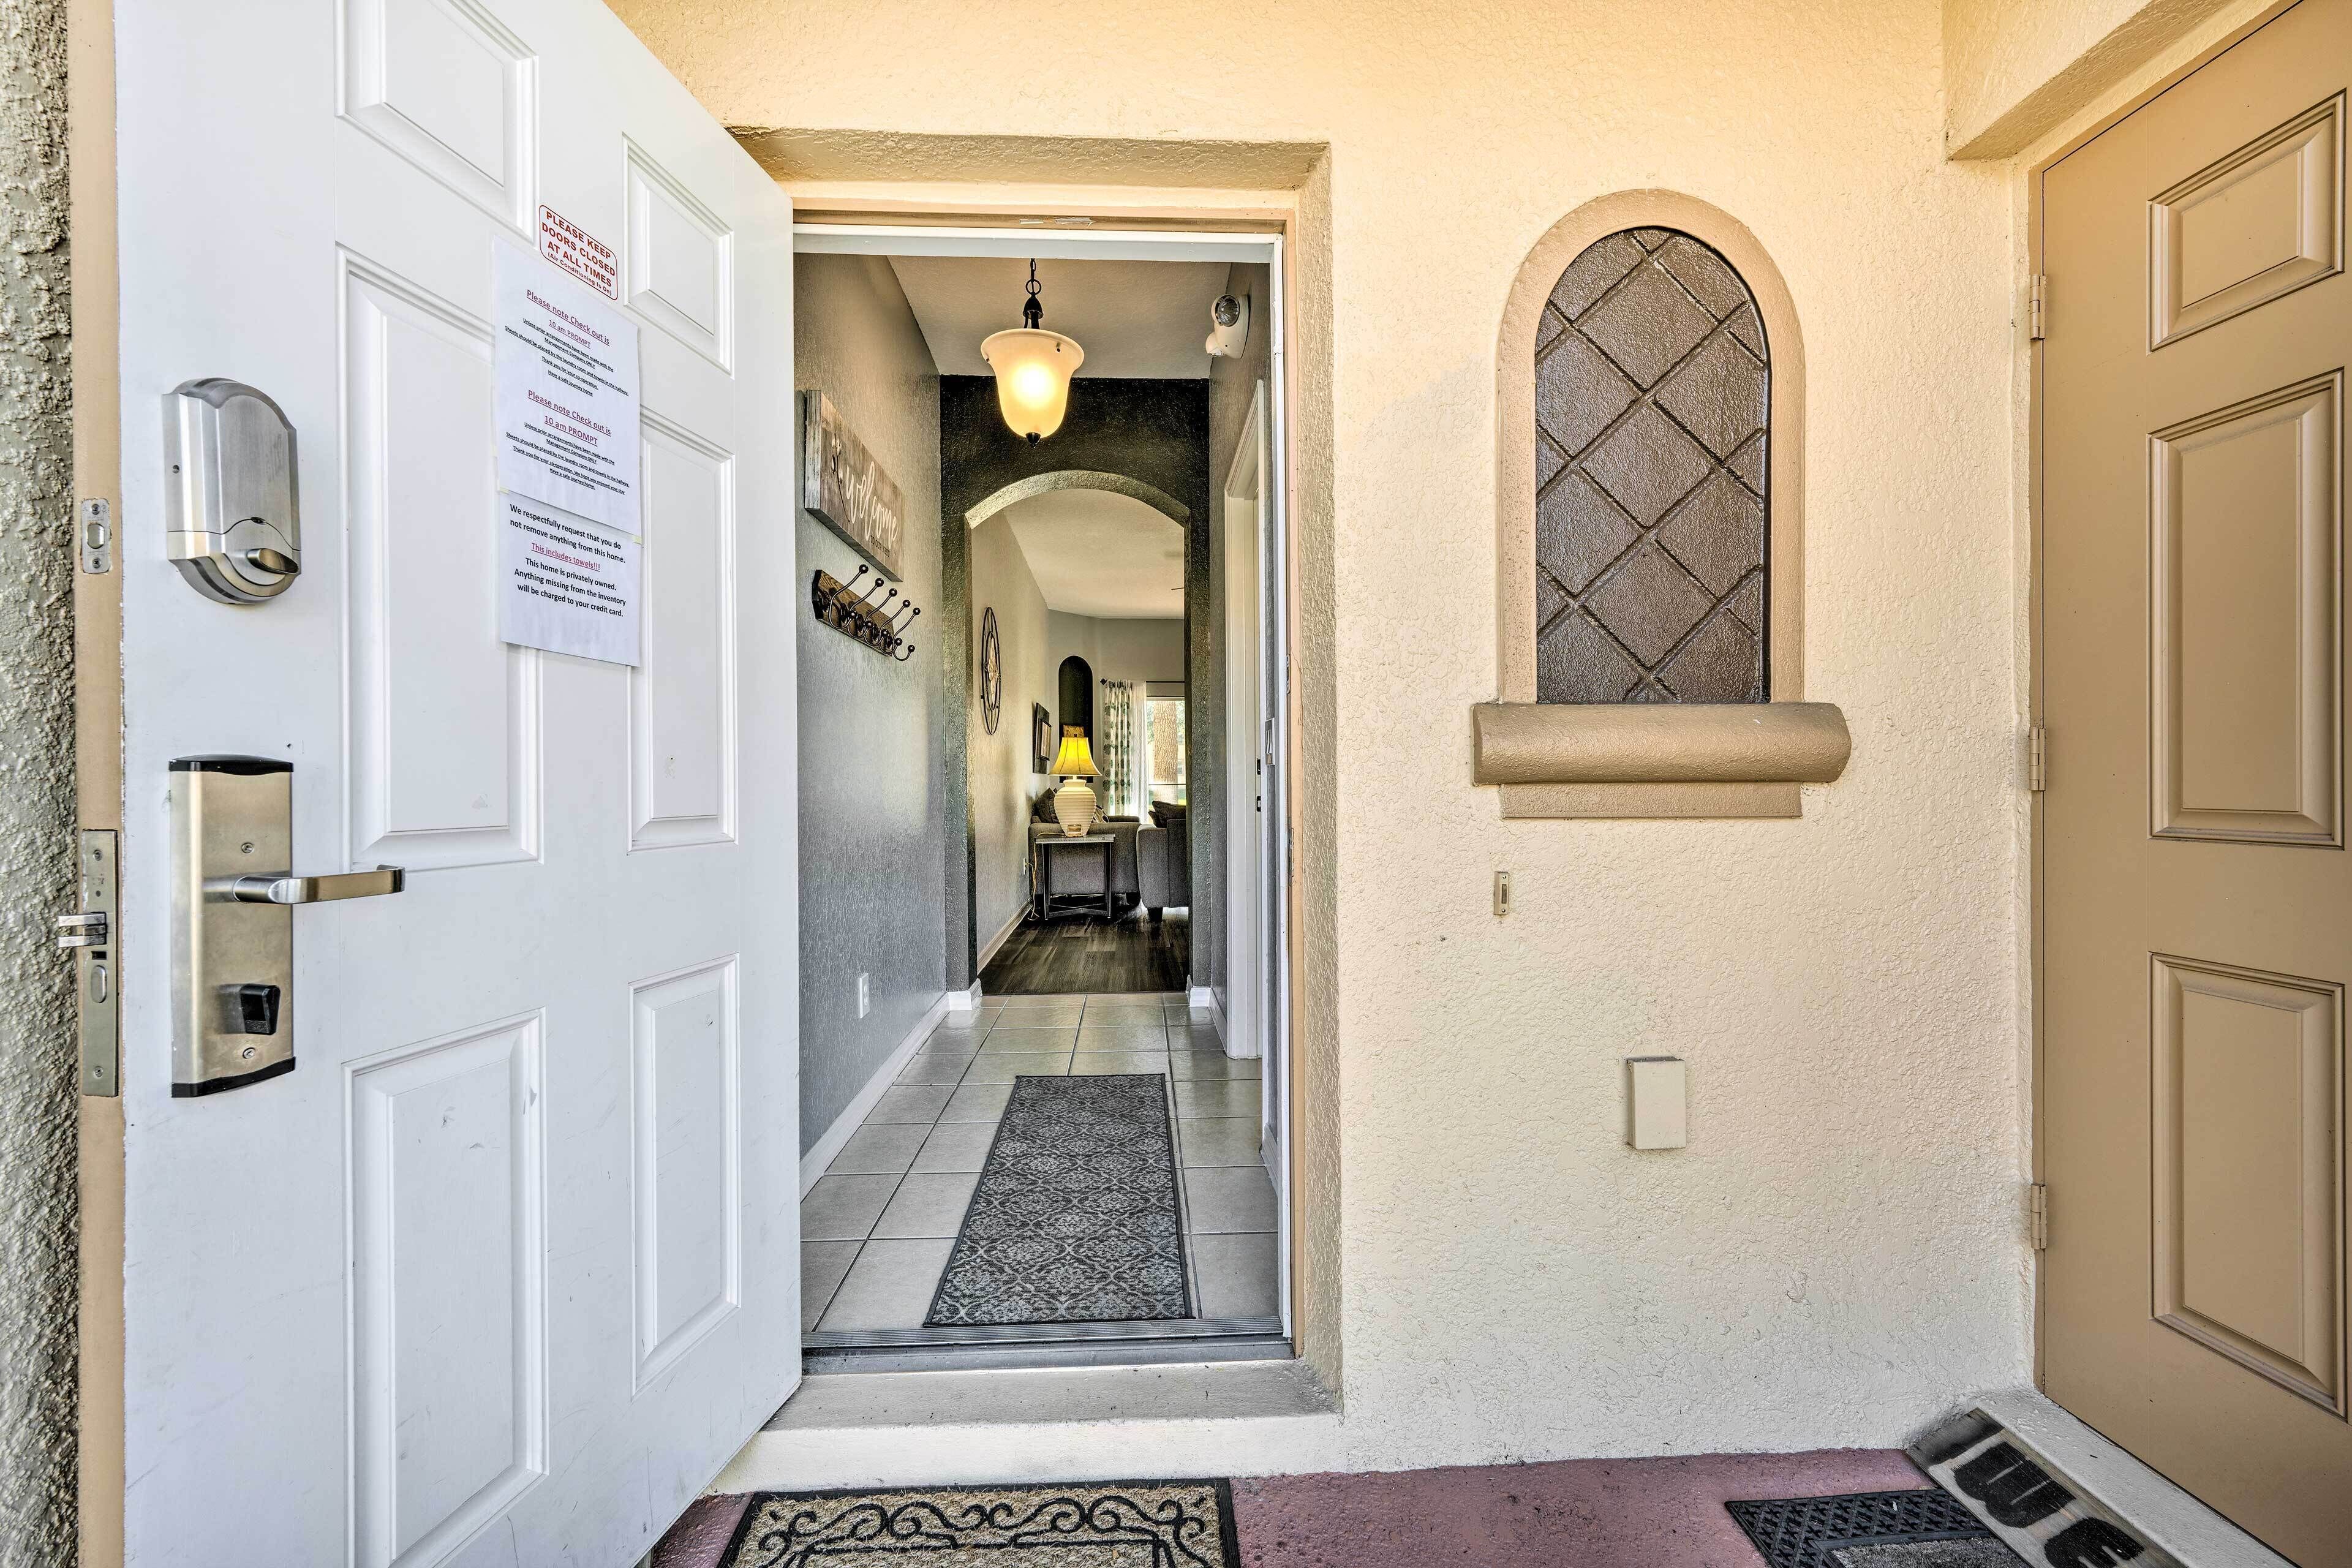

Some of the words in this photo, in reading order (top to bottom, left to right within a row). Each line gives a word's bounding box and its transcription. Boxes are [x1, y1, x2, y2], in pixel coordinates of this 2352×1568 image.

[542, 223, 576, 251] DOORS
[579, 247, 614, 276] CLOSED
[546, 211, 584, 242] PLEASE
[587, 239, 610, 260] KEEP
[548, 241, 560, 255] AT
[563, 251, 581, 267] ALL
[583, 263, 611, 287] TIMES
[548, 252, 558, 262] (Air
[560, 259, 595, 285] Conditioning
[603, 285, 611, 296] On)
[527, 290, 550, 309] Please
[552, 306, 568, 320] note
[570, 315, 590, 333] Check
[592, 330, 603, 340] out
[604, 334, 609, 344] is
[505, 325, 518, 336] Sheets
[519, 334, 531, 343] should
[538, 344, 550, 353] placed
[562, 356, 576, 369] laundry
[594, 373, 605, 382] towels
[523, 318, 535, 328] Unless
[546, 331, 571, 348] arrangements
[580, 350, 589, 358] been
[545, 337, 568, 354] Management
[569, 350, 585, 364] Company
[586, 360, 595, 368] ONLY
[567, 330, 590, 347] PROMPT
[541, 356, 552, 365] Thank
[568, 380, 582, 392] journey
[582, 387, 592, 396] home
[528, 391, 551, 407] Please
[554, 404, 570, 415] note
[571, 411, 591, 426] Check
[593, 422, 604, 431] out
[606, 426, 611, 435] is
[545, 415, 553, 425] 10
[555, 422, 566, 431] am
[568, 426, 597, 445] PROMPT
[513, 445, 524, 454] Thank
[524, 422, 537, 431] Unless
[548, 433, 573, 447] arrangements
[546, 439, 570, 453] Management
[571, 449, 587, 461] Company
[506, 432, 519, 441] Sheets
[565, 456, 578, 467] laundry
[595, 469, 606, 477] towels
[570, 475, 584, 486] journey
[510, 504, 521, 514] We
[523, 510, 560, 530] respectfully
[562, 524, 585, 537] request
[587, 531, 599, 542] that
[613, 540, 620, 549] do
[510, 520, 521, 529] not
[523, 524, 548, 537] remove
[549, 533, 576, 549] anything
[578, 541, 592, 552] from
[594, 546, 605, 556] this
[606, 551, 625, 563] home.
[526, 557, 538, 567] This
[540, 562, 558, 573] home
[566, 571, 593, 586] privately
[594, 579, 616, 590] owned.
[531, 542, 544, 552] This
[546, 547, 571, 561] includes
[573, 555, 600, 570] towels!!!
[514, 568, 543, 584] Anything
[546, 578, 568, 592] missing
[570, 584, 585, 594] from
[587, 589, 597, 597] the
[598, 592, 625, 608] inventory
[540, 589, 565, 601] charged
[575, 599, 589, 608] your
[590, 603, 607, 612] credit
